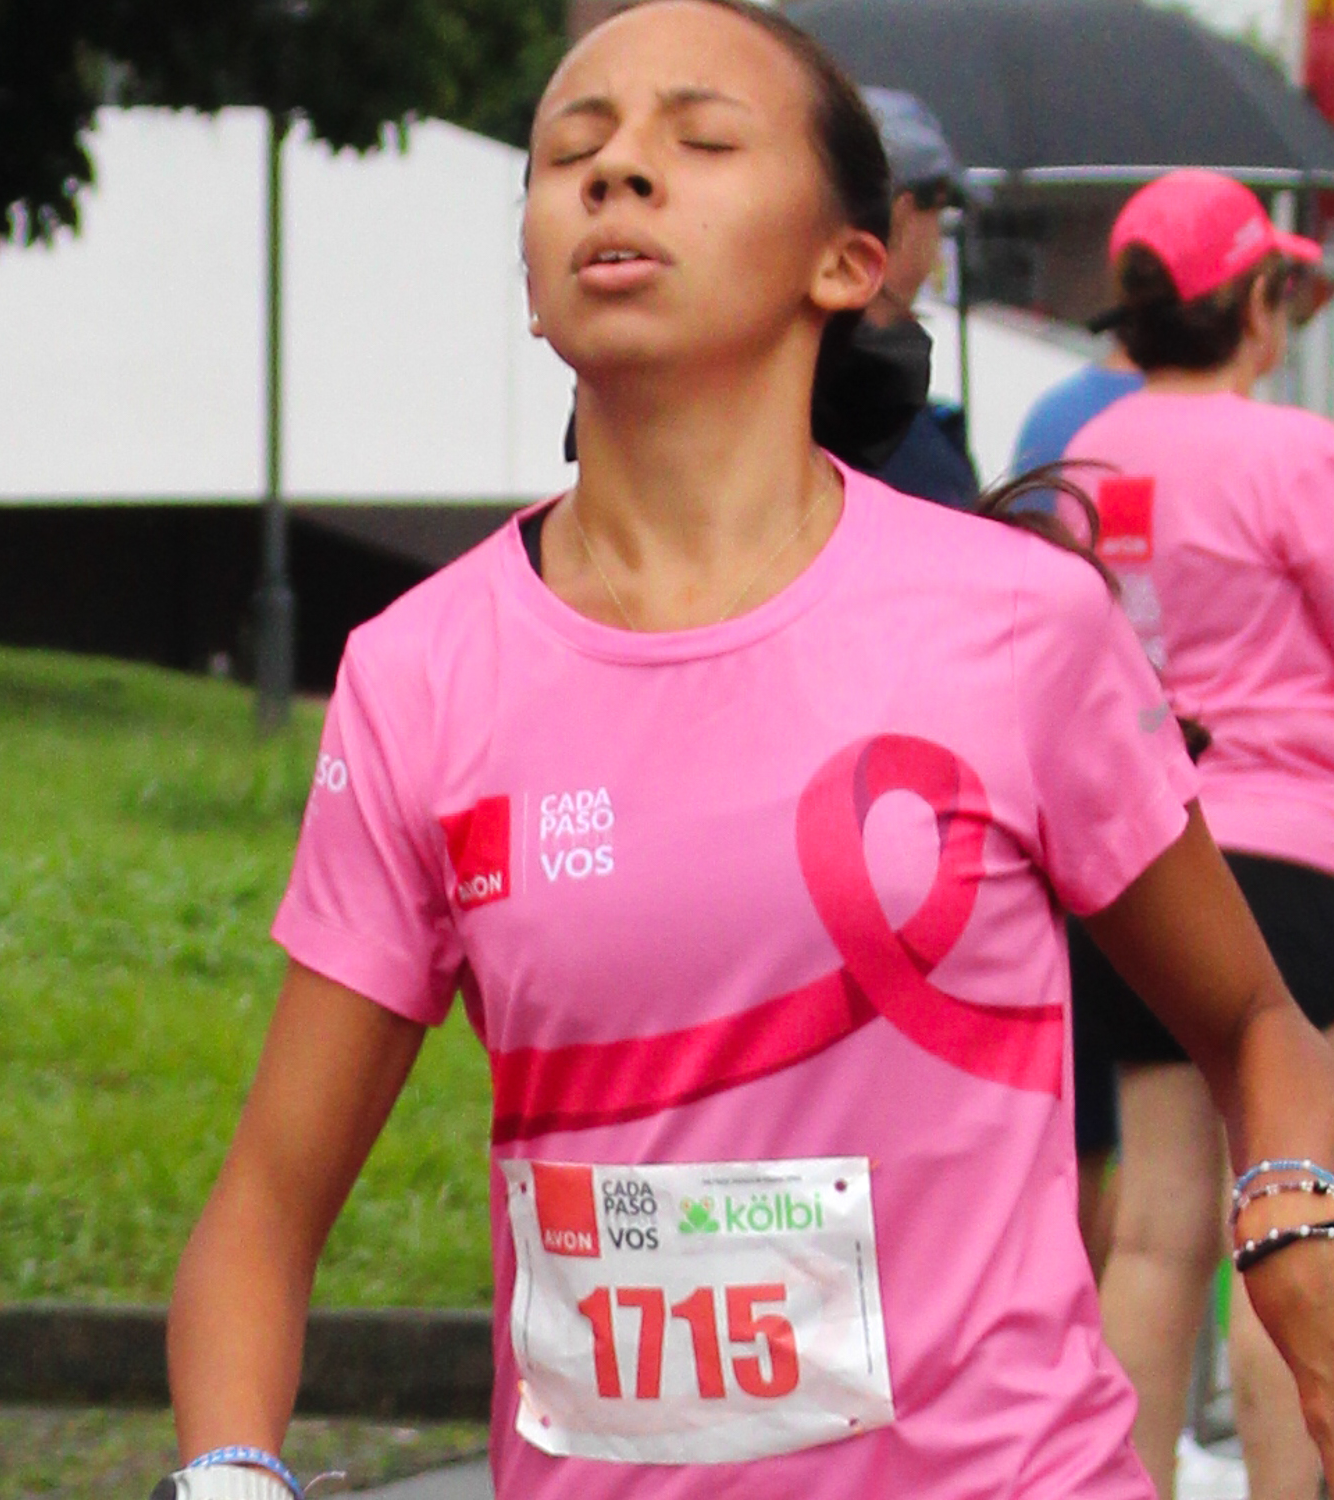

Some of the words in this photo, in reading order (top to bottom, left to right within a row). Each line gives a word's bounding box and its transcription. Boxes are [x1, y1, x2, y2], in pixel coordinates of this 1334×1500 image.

[540, 786, 611, 816] CADA
[539, 807, 615, 840] PASO
[540, 845, 615, 882] VOS
[602, 1180, 654, 1198] CADA
[604, 1196, 657, 1215] PASO
[725, 1192, 823, 1232] kölbi
[545, 1229, 593, 1250] AVON
[608, 1227, 658, 1250] VOS
[578, 1283, 800, 1400] 1715
